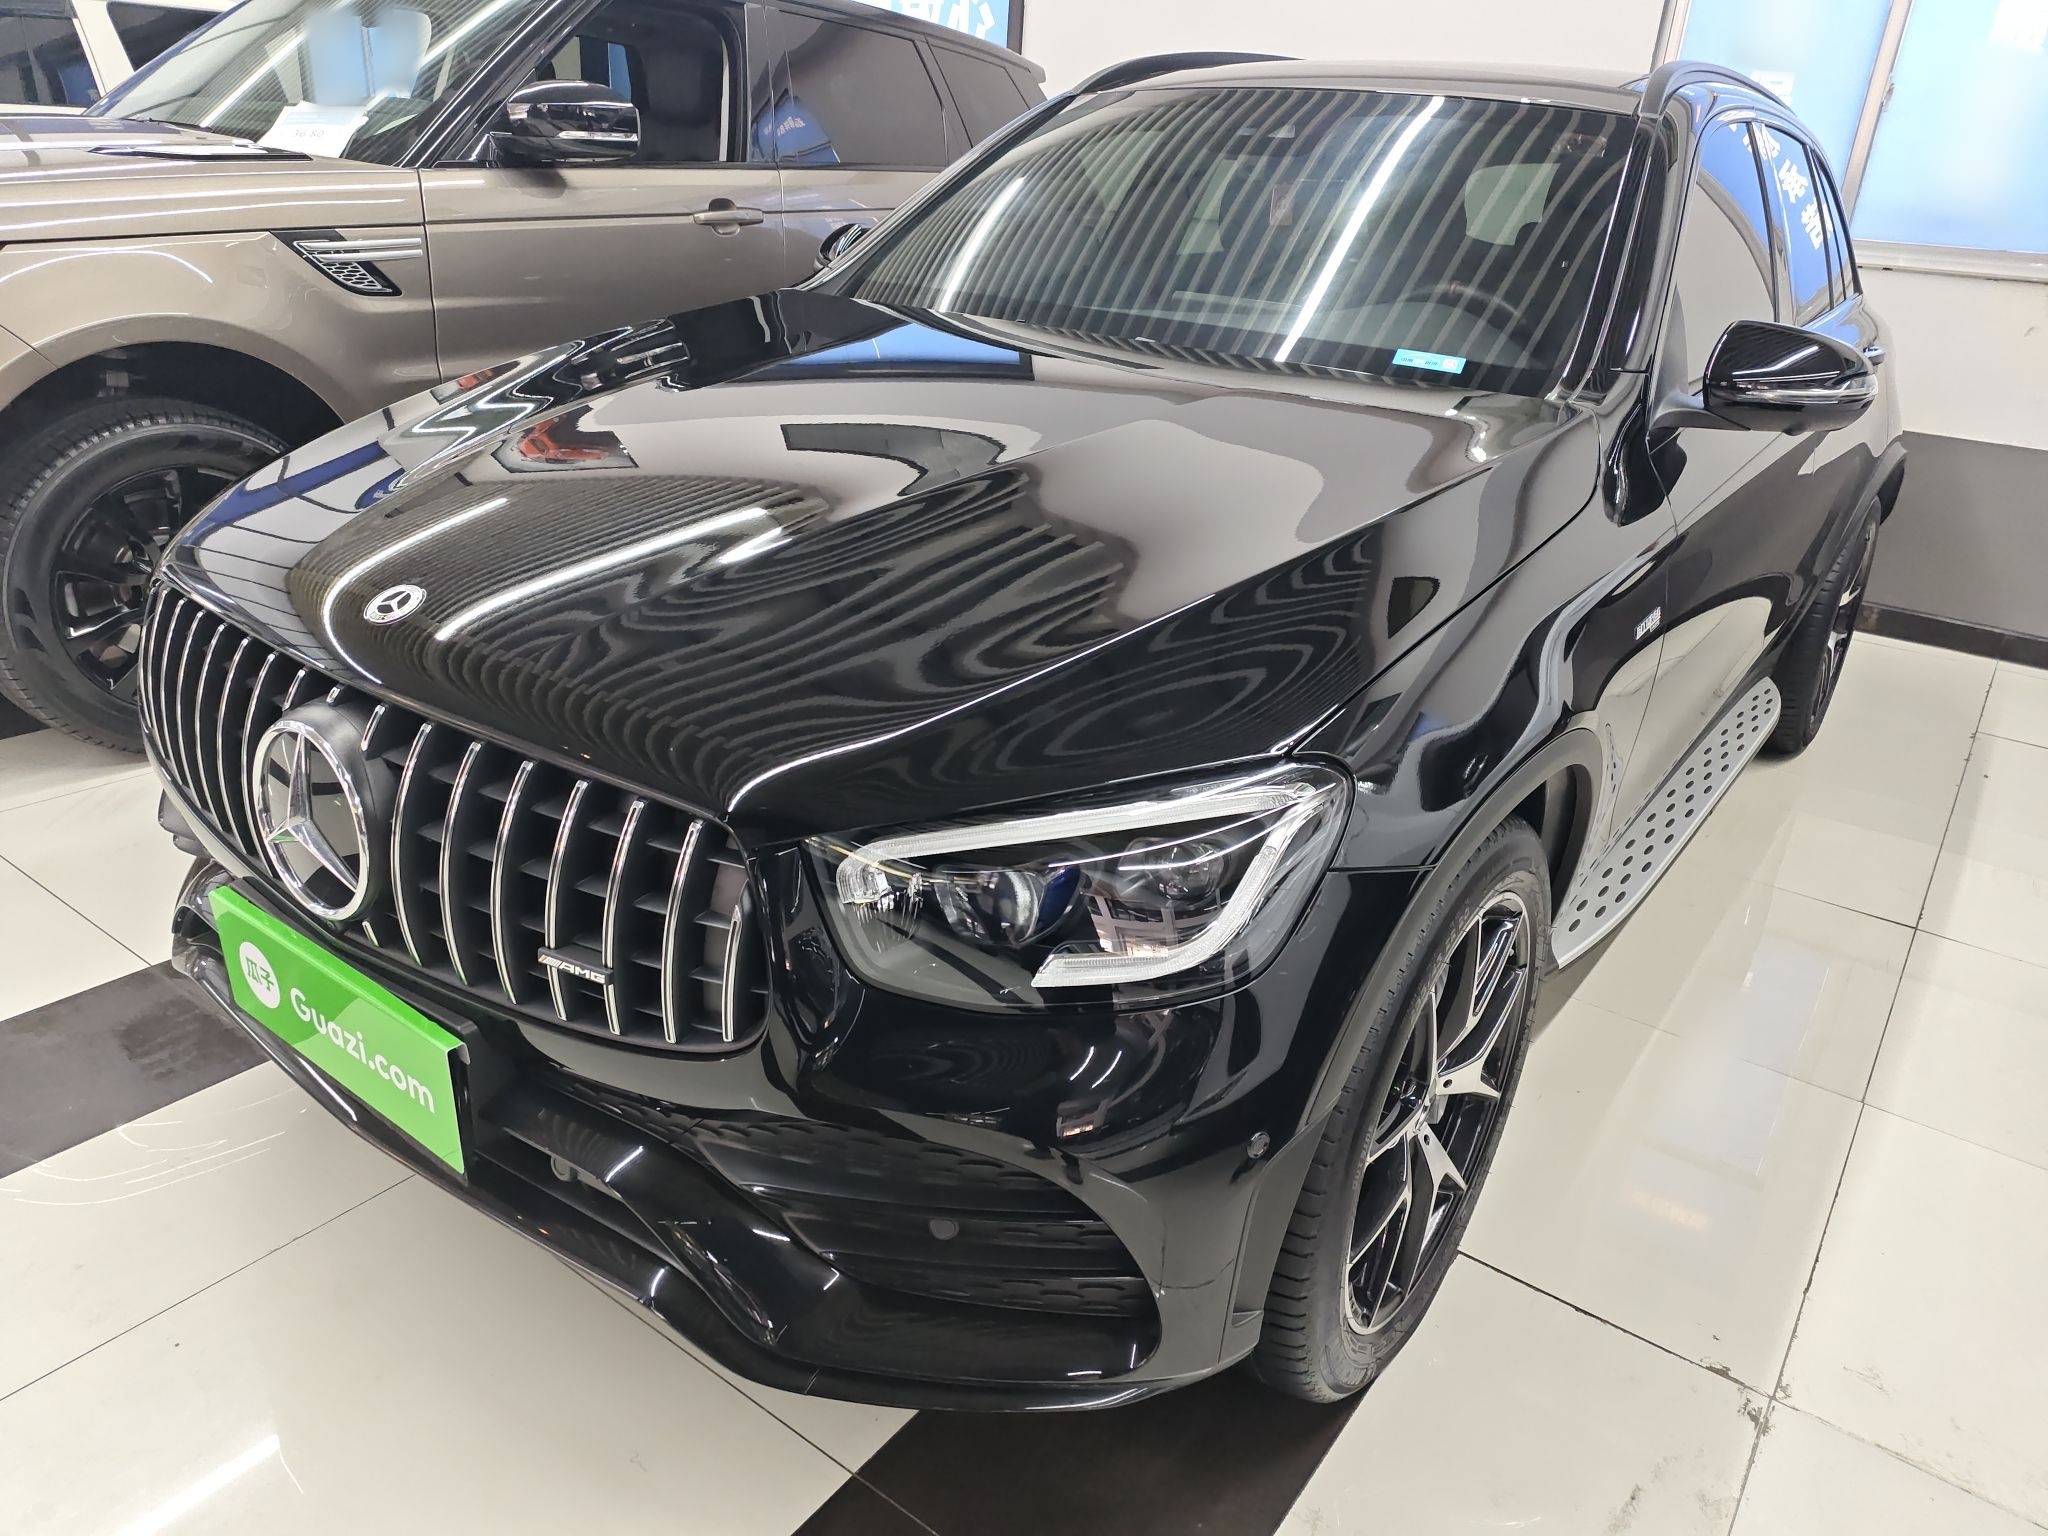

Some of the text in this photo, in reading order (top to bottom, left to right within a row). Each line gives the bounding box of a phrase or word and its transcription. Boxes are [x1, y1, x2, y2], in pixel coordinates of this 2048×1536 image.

[245, 956, 275, 992] 瓜子
[557, 961, 606, 984] AMG
[290, 987, 435, 1114] Guazi.com
